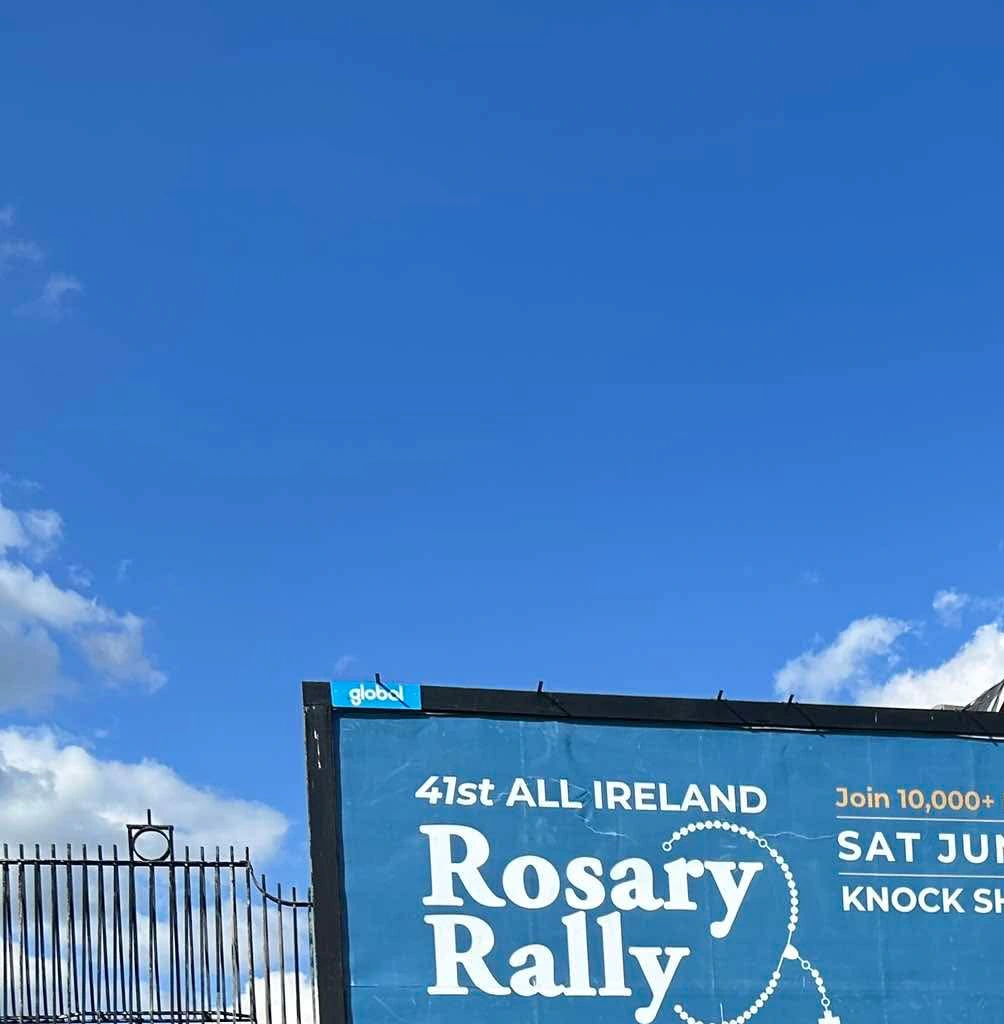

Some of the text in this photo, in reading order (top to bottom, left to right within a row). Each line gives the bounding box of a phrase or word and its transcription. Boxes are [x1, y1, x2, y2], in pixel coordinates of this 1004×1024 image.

[349, 683, 405, 706] global
[415, 776, 768, 814] 41st ALL IRELAND
[835, 786, 890, 809] Join
[896, 788, 995, 814] 10,000+
[838, 831, 921, 862] SAT
[419, 824, 763, 938] Rosary
[842, 886, 964, 914] KNOCK
[423, 911, 691, 1024] Rally
